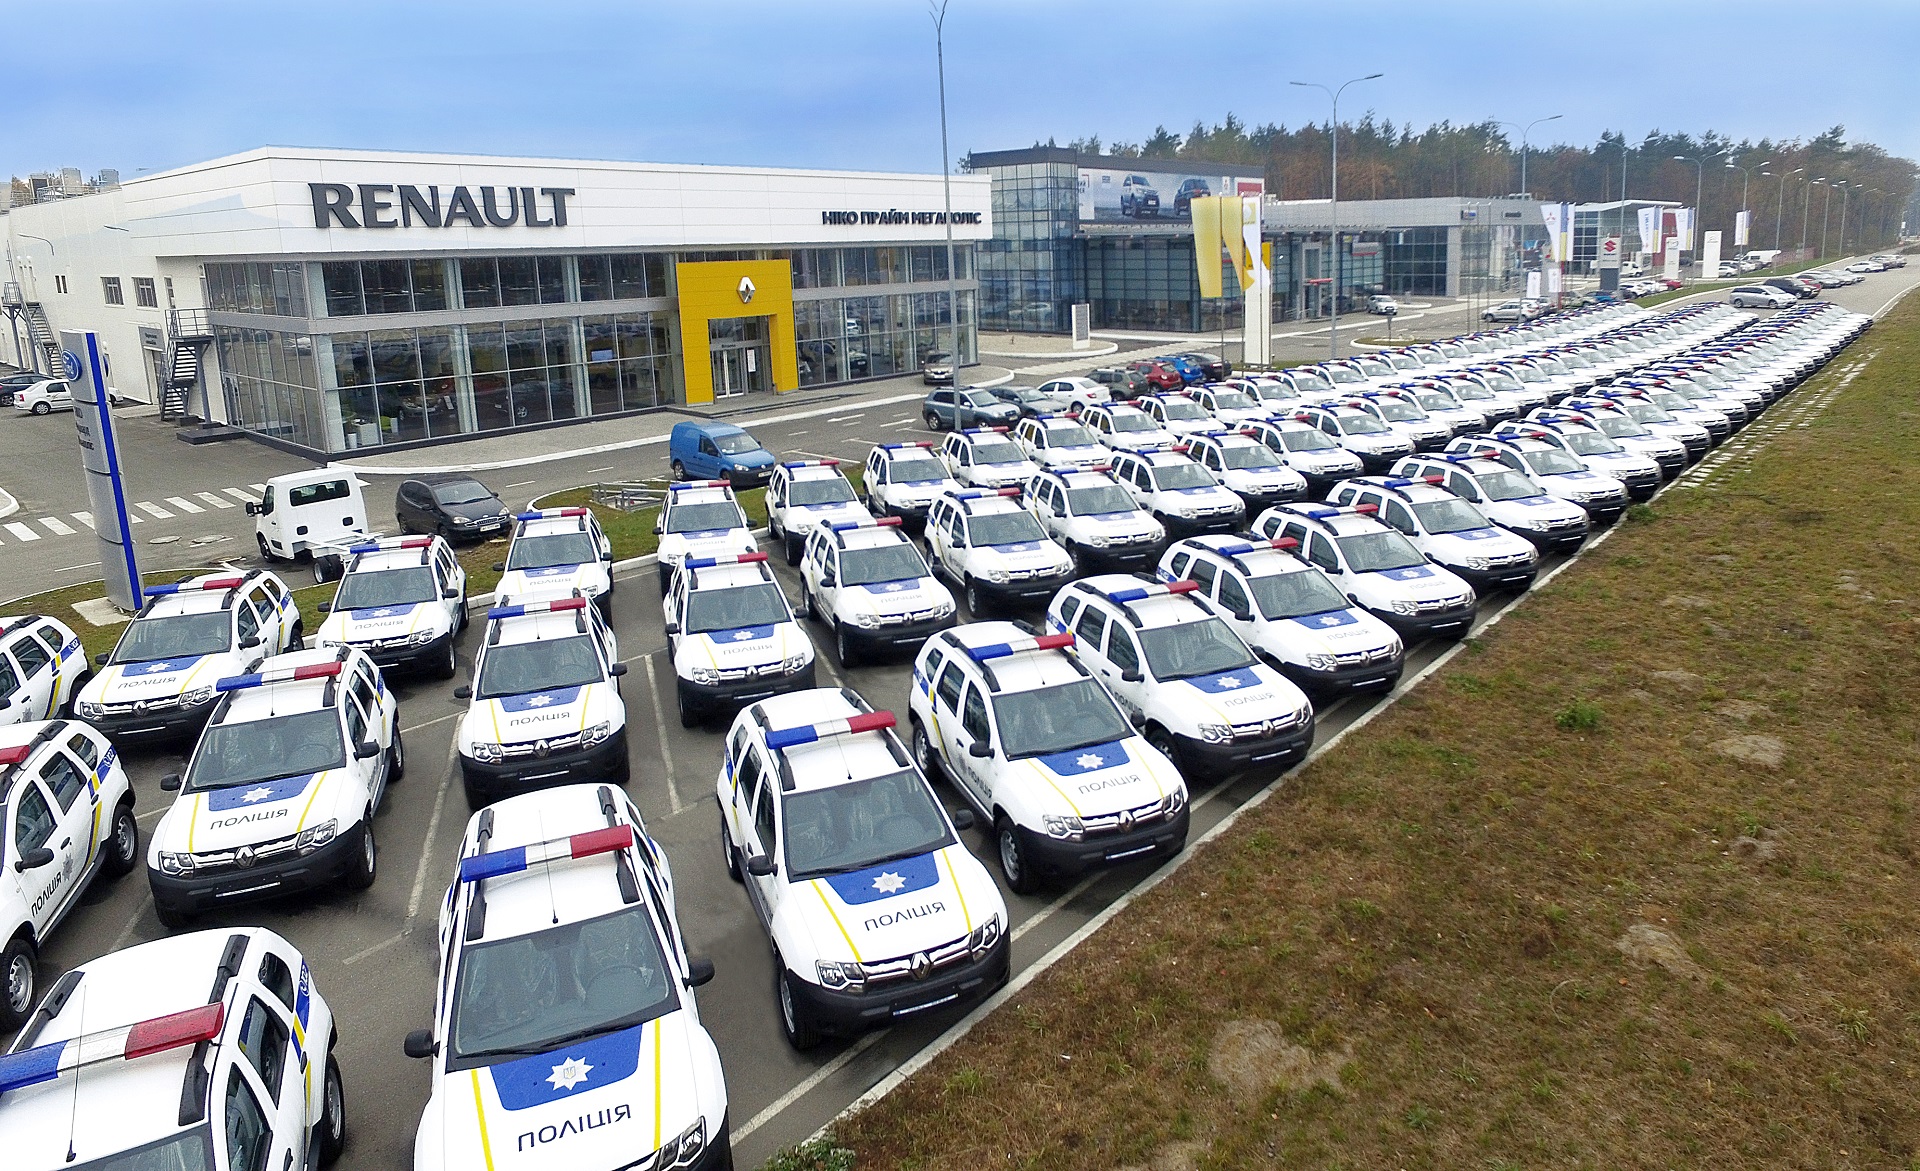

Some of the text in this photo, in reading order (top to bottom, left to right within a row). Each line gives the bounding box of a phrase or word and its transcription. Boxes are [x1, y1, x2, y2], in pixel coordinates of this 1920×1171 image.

[307, 182, 576, 229] RENAULT
[821, 210, 859, 225] НІКО
[860, 208, 910, 225] ПРАЙМ
[354, 619, 404, 630] ПОЛІЦІЯ
[723, 644, 773, 655] ПОЛІЦІЯ
[117, 676, 176, 690] ПОЛІЦІЯ
[1224, 692, 1276, 708] ПОЛІЦІЯ
[510, 711, 571, 727] ПОЛІЦІЯ
[1078, 774, 1141, 794] ПОЛІЦІЯ
[209, 808, 288, 831] ПОЛІЦІЯ
[31, 871, 63, 918] ПОЛІЦІЯ
[864, 901, 947, 932] ПОЛІЦІЯ
[518, 1104, 631, 1152] ПОЛІЦІЯ
